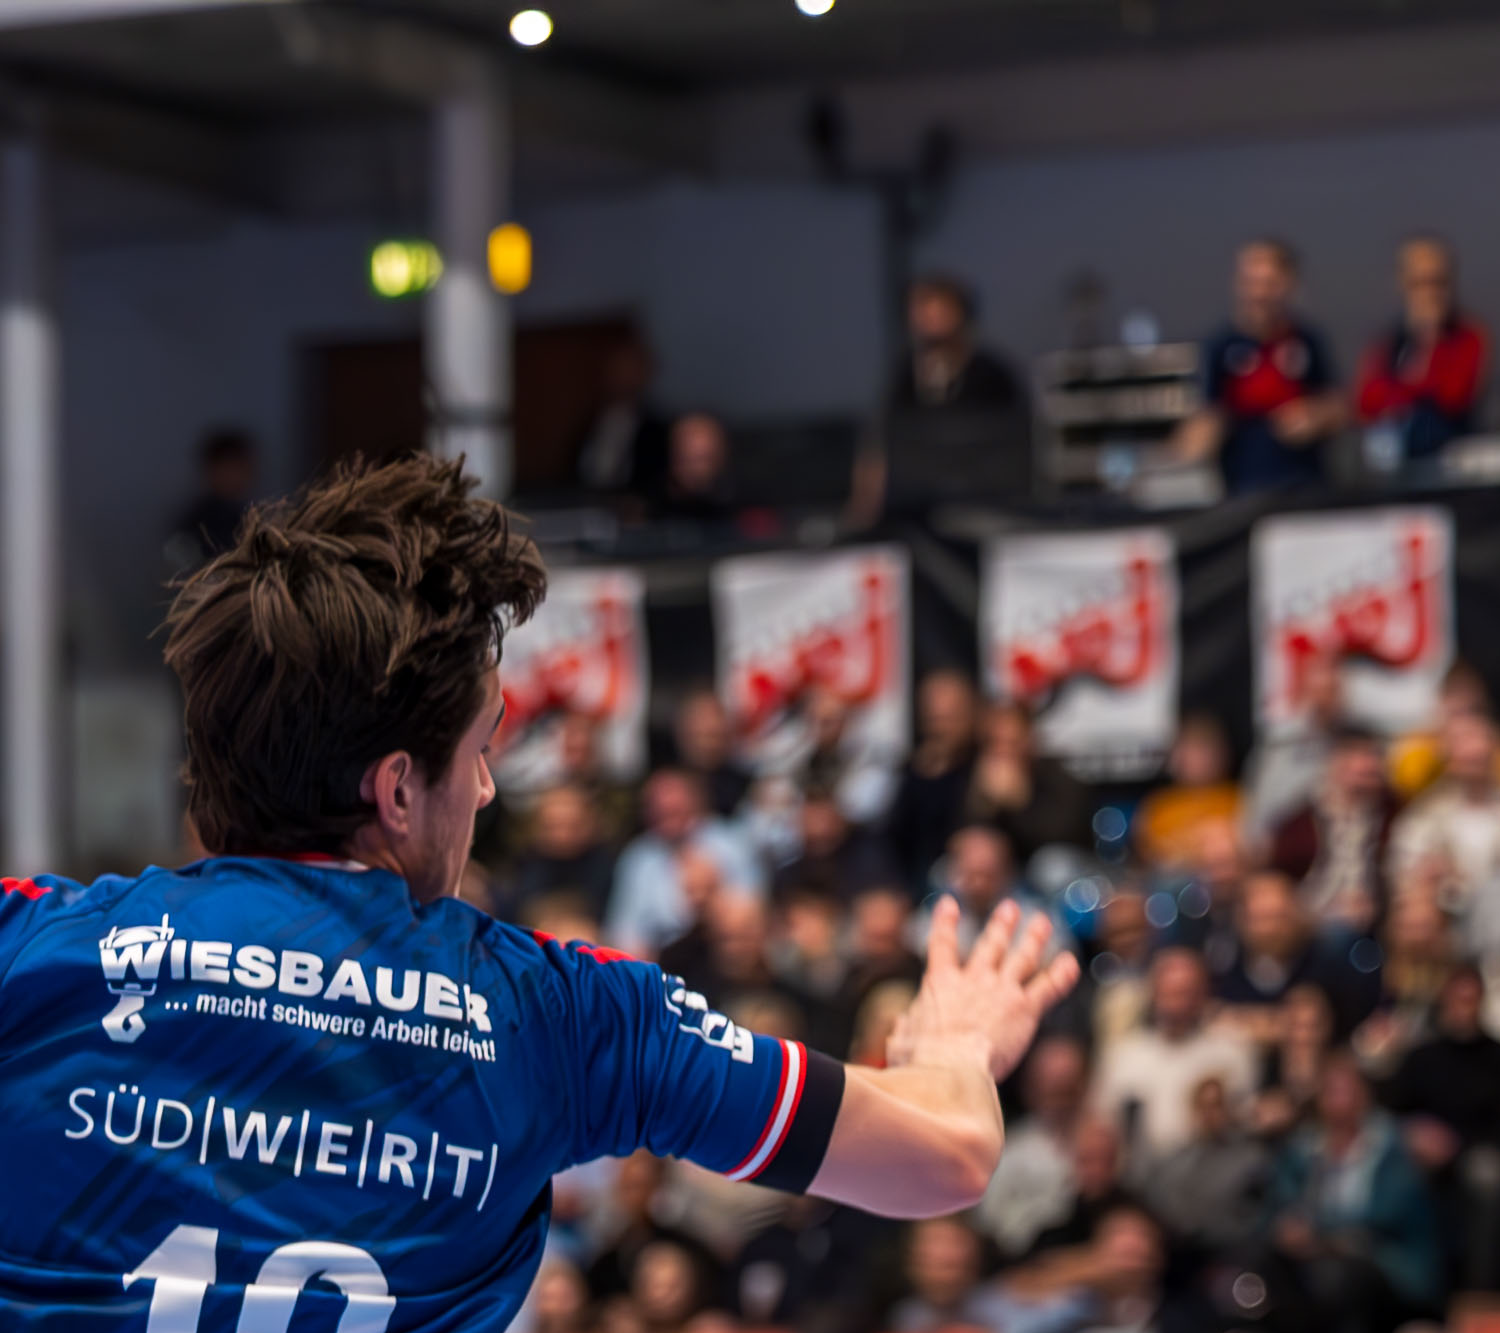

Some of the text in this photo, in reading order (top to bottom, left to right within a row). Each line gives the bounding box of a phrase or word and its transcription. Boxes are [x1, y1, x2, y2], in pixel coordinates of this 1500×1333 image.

[196, 993, 267, 1020] macht
[272, 1002, 366, 1037] schwere
[371, 1015, 438, 1049] Arbeit
